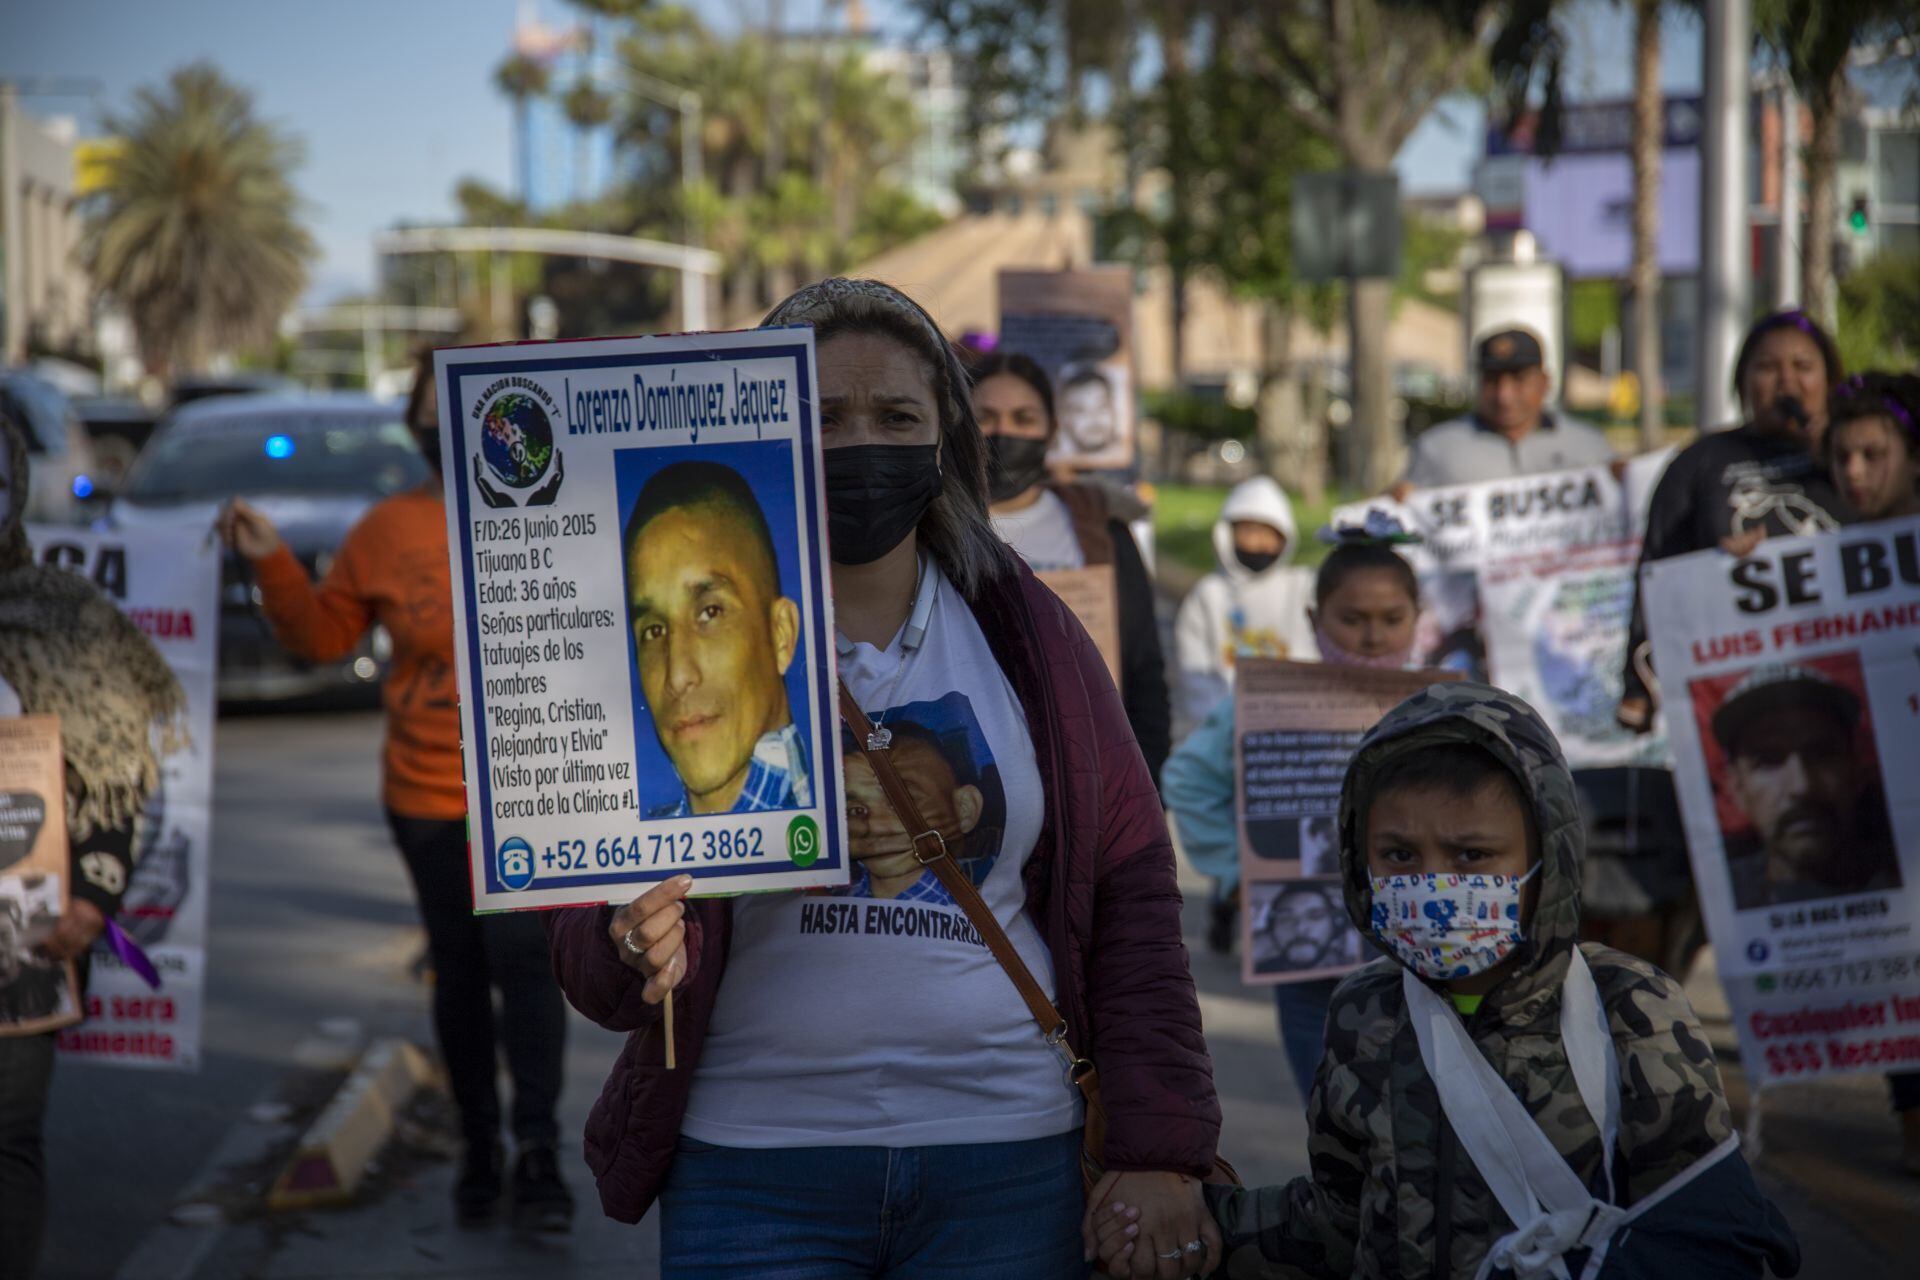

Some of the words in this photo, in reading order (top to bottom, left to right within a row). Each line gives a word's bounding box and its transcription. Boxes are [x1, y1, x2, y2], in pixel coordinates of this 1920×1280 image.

[565, 378, 630, 435] Lorenzo
[634, 369, 726, 444] Domínguez
[730, 368, 788, 440] Jaquez
[1431, 491, 1468, 528] SE
[1488, 476, 1603, 520] BUSCA
[475, 518, 521, 543] F/D:26
[521, 516, 559, 546] Junio
[561, 514, 597, 538] 2015
[476, 548, 527, 577] Tijuana
[531, 550, 542, 570] B
[543, 548, 554, 569] C
[480, 583, 518, 605] Edad:
[521, 582, 541, 602] 36
[543, 578, 577, 601] años
[1731, 546, 1823, 614] SE
[482, 611, 524, 636] Señas
[527, 608, 615, 639] particulares:
[484, 643, 541, 672] tatuajes
[544, 641, 561, 662] de
[564, 640, 585, 661] los
[1692, 629, 1764, 666] LUIS
[486, 673, 548, 698] nombres
[491, 734, 558, 759] Alejandra
[560, 736, 570, 756] y
[572, 731, 608, 753] Elvia"
[493, 766, 532, 790] (Visto
[535, 768, 559, 793] por
[562, 761, 606, 786] última
[607, 761, 631, 780] vez
[495, 800, 534, 820] cerca
[537, 796, 554, 817] de
[556, 795, 571, 815] la
[574, 789, 619, 817] Clínica
[542, 838, 588, 870] +52
[595, 835, 641, 867] 664
[648, 832, 694, 864] 712
[702, 828, 765, 860] 3862
[799, 903, 859, 935] HASTA
